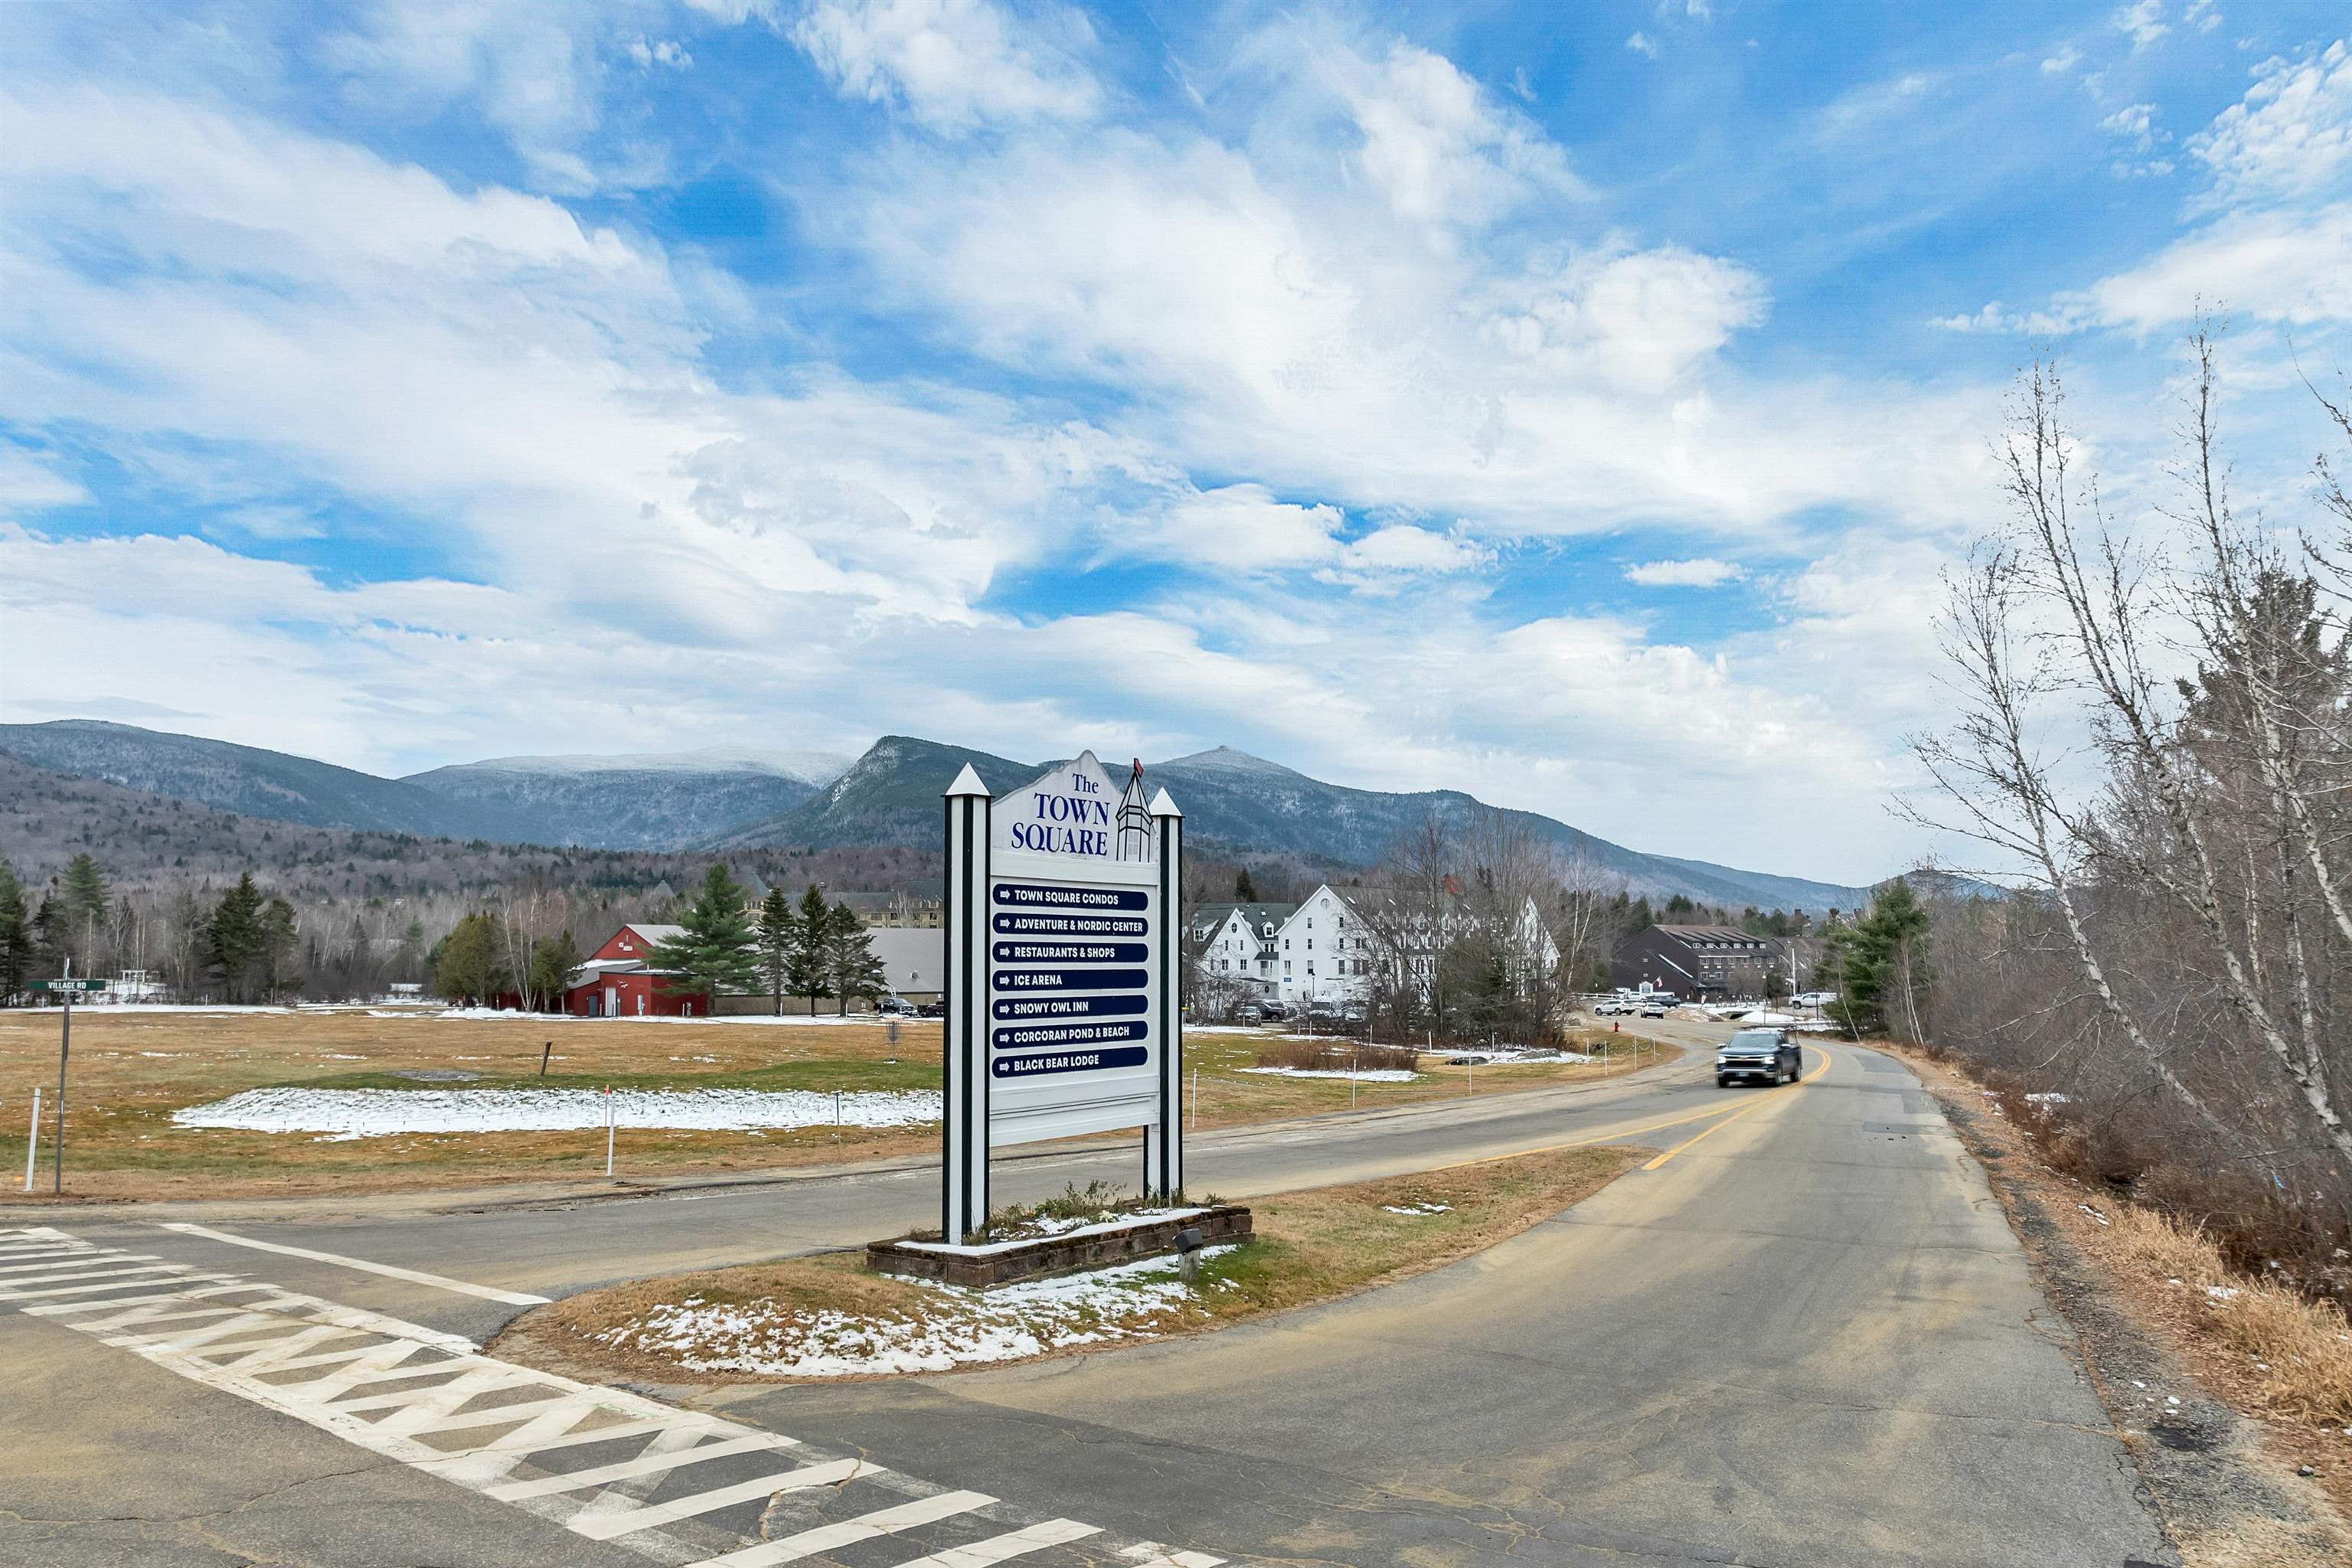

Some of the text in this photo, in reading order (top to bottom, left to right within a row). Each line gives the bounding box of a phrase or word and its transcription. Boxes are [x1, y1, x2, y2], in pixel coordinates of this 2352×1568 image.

[1073, 773, 1099, 794] The
[1034, 792, 1110, 826] TOWN
[1011, 822, 1108, 856] SQUARE
[1014, 890, 1119, 905] TOWN SQUARE CONDOS
[1014, 919, 1143, 932] ADVENTURE & NORDIC CENTER
[1014, 947, 1115, 958] RESTAURANTS & SHOPS
[1014, 975, 1063, 985] ICE ARENA
[1014, 1001, 1089, 1014] SNOWY OWL INN
[1014, 1027, 1130, 1043] CORCORAN POND & BEACH
[1014, 1055, 1099, 1071] BLACK BEAR LODGE
